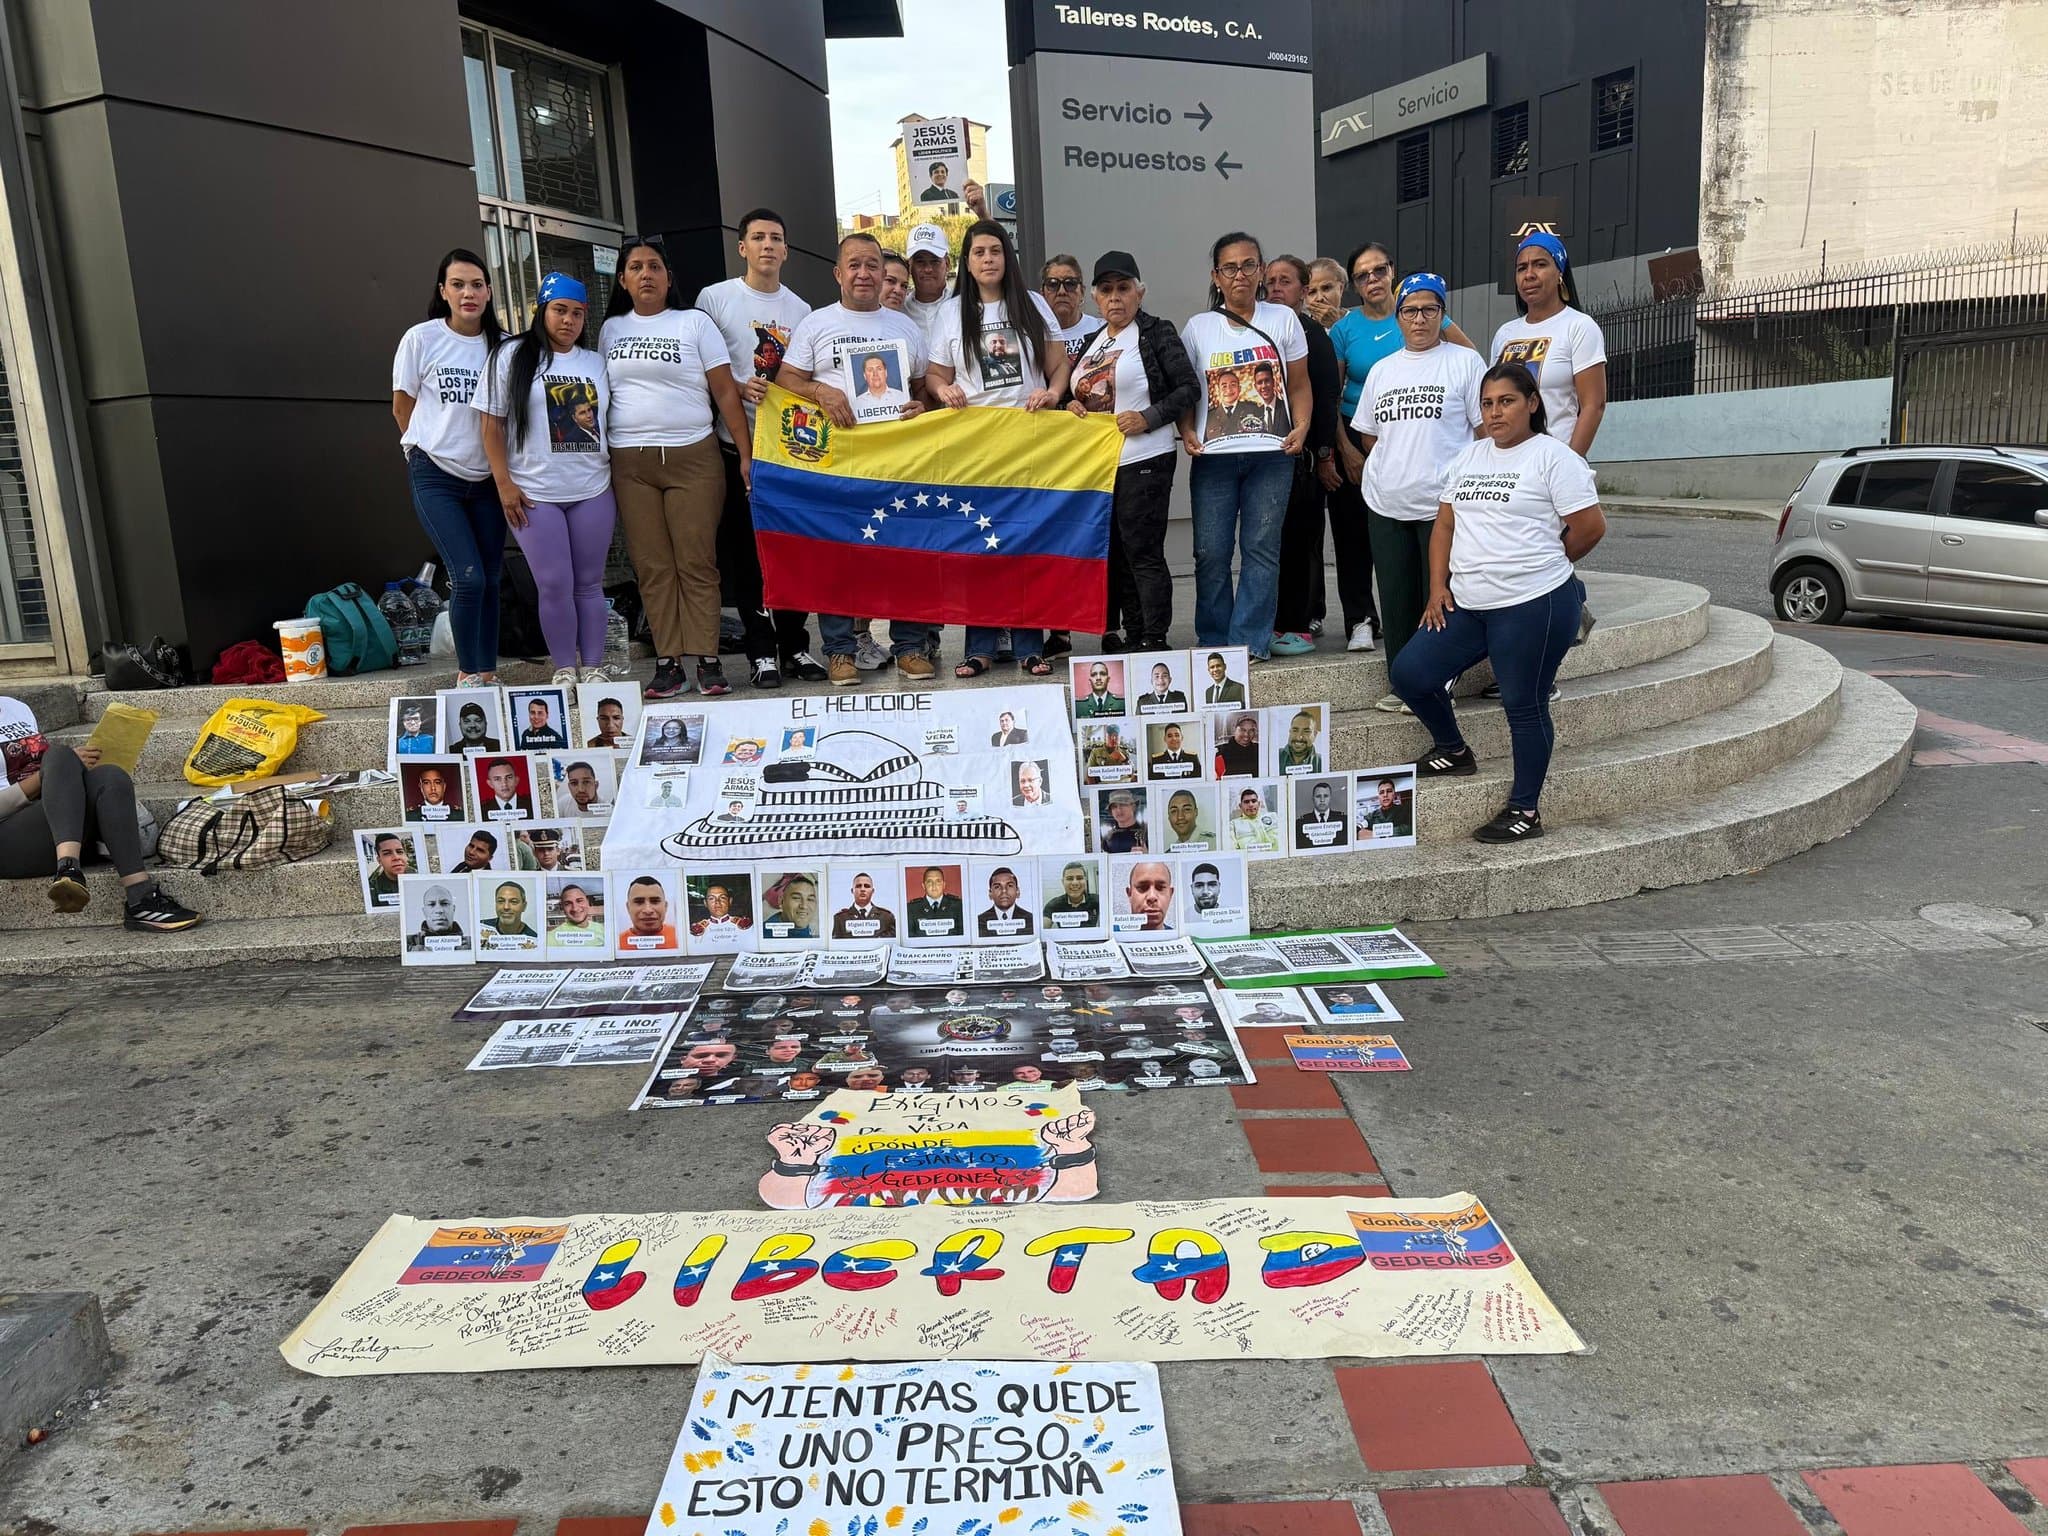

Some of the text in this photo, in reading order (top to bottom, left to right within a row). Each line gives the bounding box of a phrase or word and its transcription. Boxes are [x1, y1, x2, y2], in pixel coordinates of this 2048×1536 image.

[1055, 6, 1263, 41] Talleres Rootes, C.A.
[1267, 51, 1309, 65] J000429162
[1397, 83, 1460, 118] Servicio
[1061, 97, 1172, 126] Servicio
[912, 123, 955, 138] JESÚS
[914, 135, 957, 148] ARMAS
[1063, 145, 1207, 175] Repuestos
[613, 335, 643, 345] LIBEREN
[652, 336, 680, 345] TODOS
[630, 341, 680, 353] PRESOS
[833, 337, 867, 346] LIBEREN
[846, 344, 875, 355] RICARDO
[437, 367, 471, 379] LIBEREN
[438, 377, 461, 391] LOS
[1418, 384, 1446, 394] TODOS
[1375, 393, 1444, 411] LOS PRESOS
[1374, 405, 1443, 424] POLÍTICOS
[1477, 480, 1516, 490] PRESOS
[1454, 485, 1510, 503] POLÍTICOS
[792, 693, 933, 720] EL HELICOIDE
[925, 733, 954, 742] VERA
[724, 785, 756, 793] ARMAS
[1128, 944, 1184, 953] TOCUYITO
[743, 955, 776, 964] ZONA
[518, 971, 553, 979] RODEO
[514, 1021, 577, 1036] YARE
[599, 1016, 663, 1030] EL INOF
[1296, 1036, 1346, 1047] donde
[989, 1045, 1025, 1053] TODOS
[1362, 1215, 1423, 1229] donde
[508, 1228, 543, 1241] vida
[1370, 1253, 1511, 1269] GEDEONES.
[418, 1269, 526, 1282] GEDEONES.
[582, 1226, 1367, 1311] LIBERTAD
[726, 1378, 1141, 1419] MIENTRAS QUEDE
[779, 1425, 873, 1469] UNO
[686, 1475, 803, 1517] ESTO
[825, 1468, 886, 1507] NO
